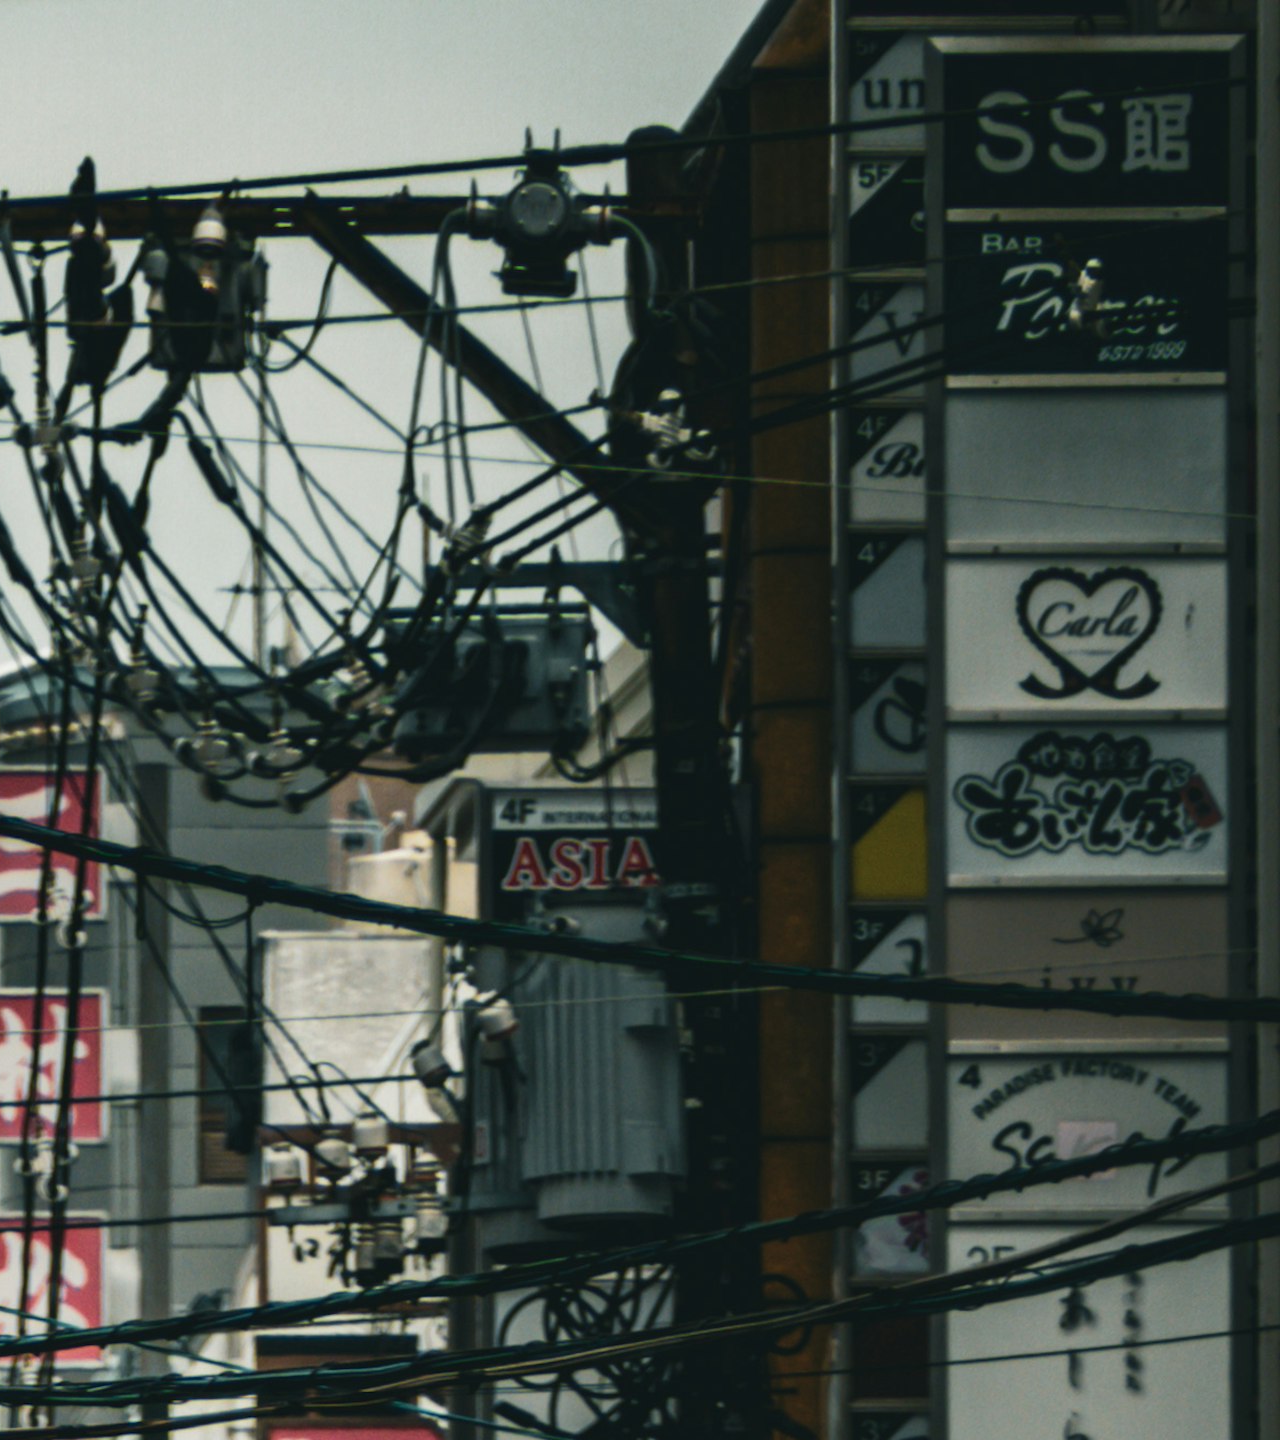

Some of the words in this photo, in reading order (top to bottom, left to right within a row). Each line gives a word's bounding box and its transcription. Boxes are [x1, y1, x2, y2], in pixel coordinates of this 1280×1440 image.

[975, 88, 1193, 174] SS館
[858, 163, 891, 188] 5F
[981, 233, 1044, 256] BAR
[856, 415, 888, 441] 4F
[1037, 586, 1141, 640] Carla
[501, 797, 537, 825] 4F
[501, 836, 663, 891] ASIA
[854, 917, 883, 939] 3F
[957, 1066, 981, 1093] 4
[972, 1062, 1056, 1121] PARADISE
[1060, 1058, 1149, 1088] FACTORY
[1154, 1079, 1203, 1120] TEAM
